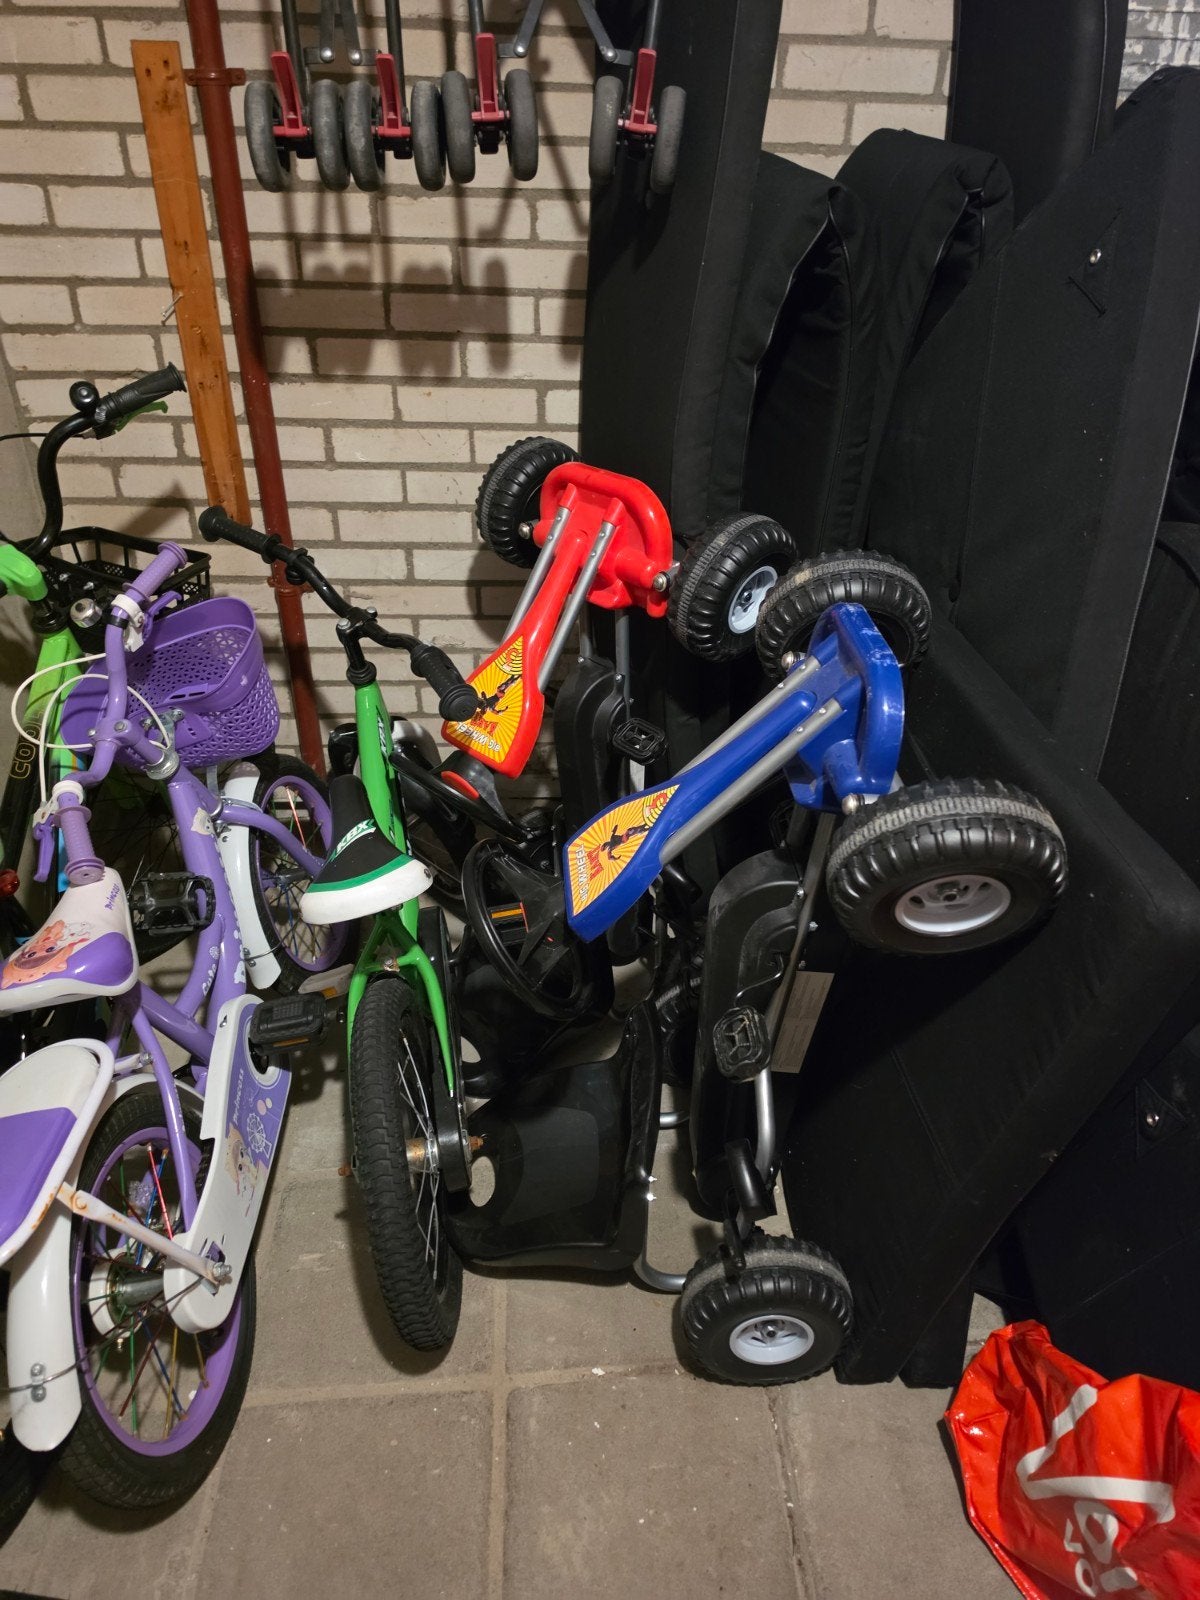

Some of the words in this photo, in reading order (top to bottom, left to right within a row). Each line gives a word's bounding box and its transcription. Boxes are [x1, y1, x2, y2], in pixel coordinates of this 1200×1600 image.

[456, 721, 489, 746] WHEEL
[486, 738, 502, 752] BIG
[336, 818, 371, 855] KBX
[575, 844, 588, 885] WHEEL
